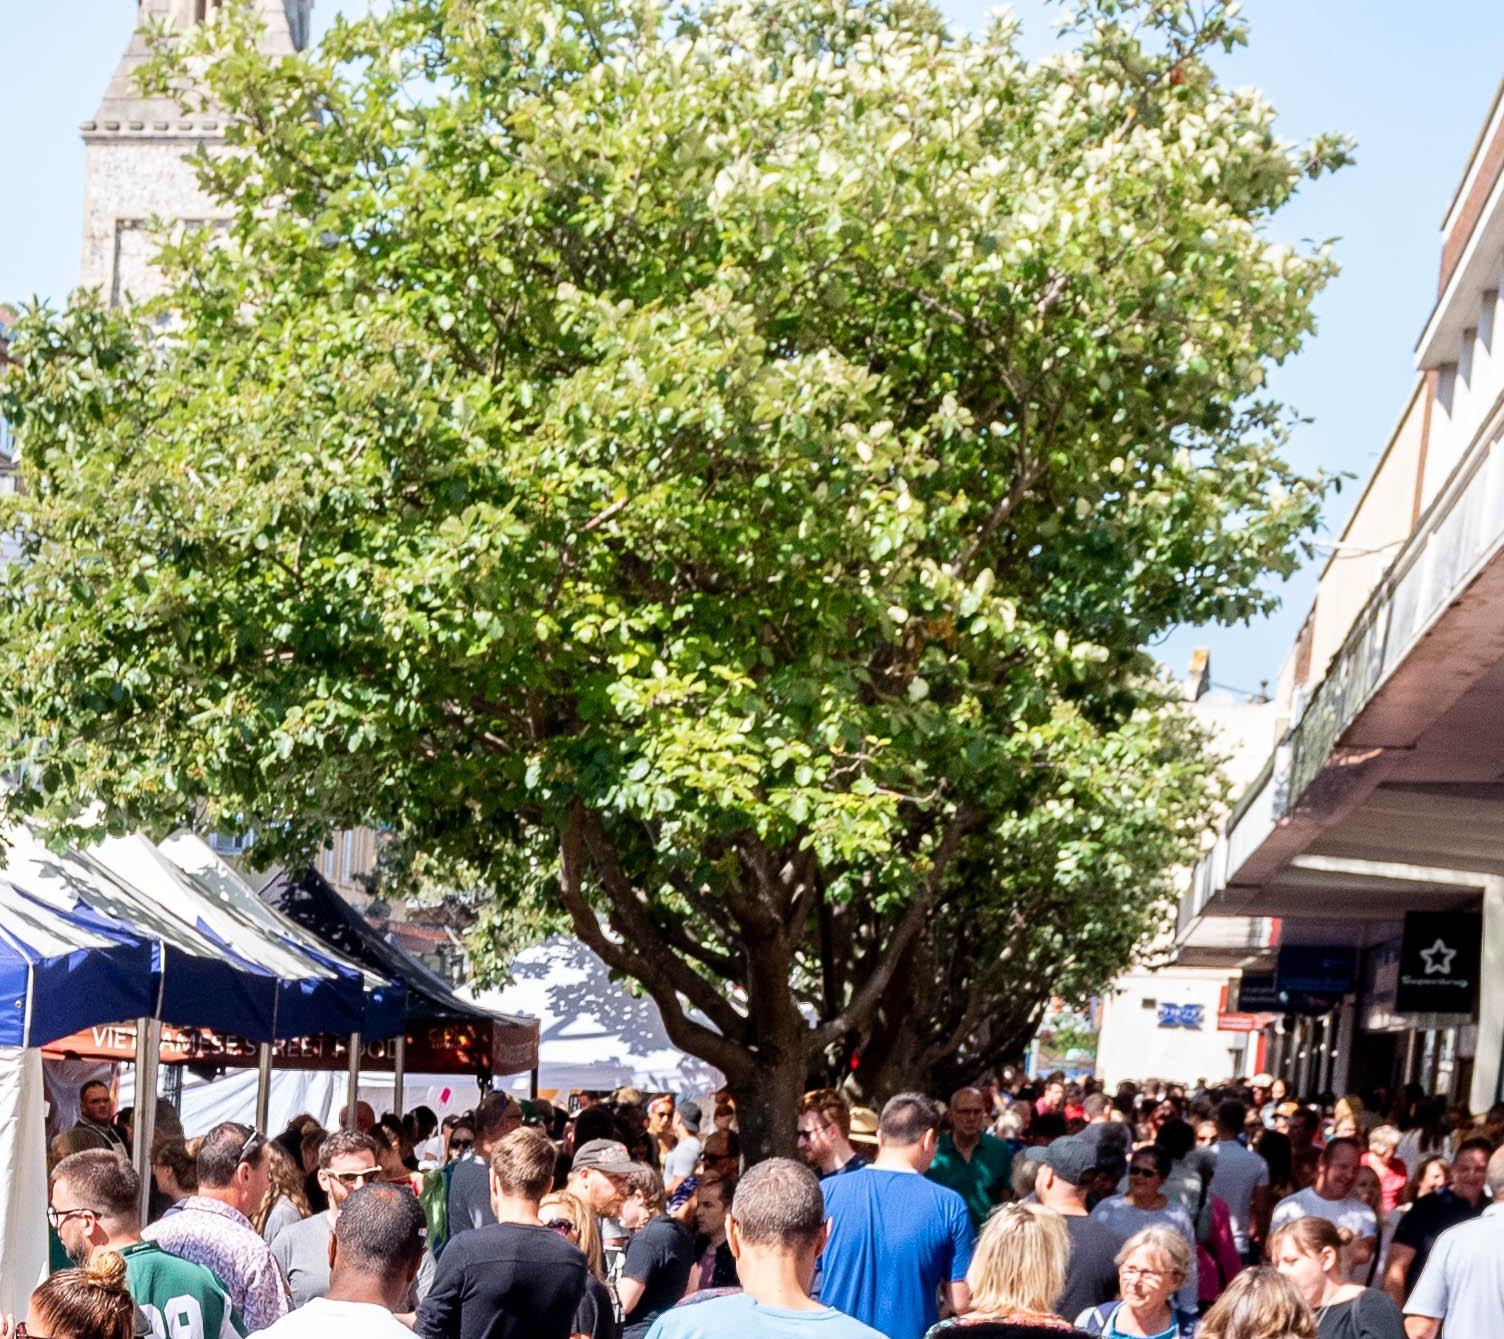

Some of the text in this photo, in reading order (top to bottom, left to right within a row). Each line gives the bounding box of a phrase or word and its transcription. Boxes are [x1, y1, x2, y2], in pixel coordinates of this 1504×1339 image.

[91, 1025, 242, 1057] VIETAMESE
[244, 1035, 324, 1059] SREET
[331, 1036, 398, 1060] FOD
